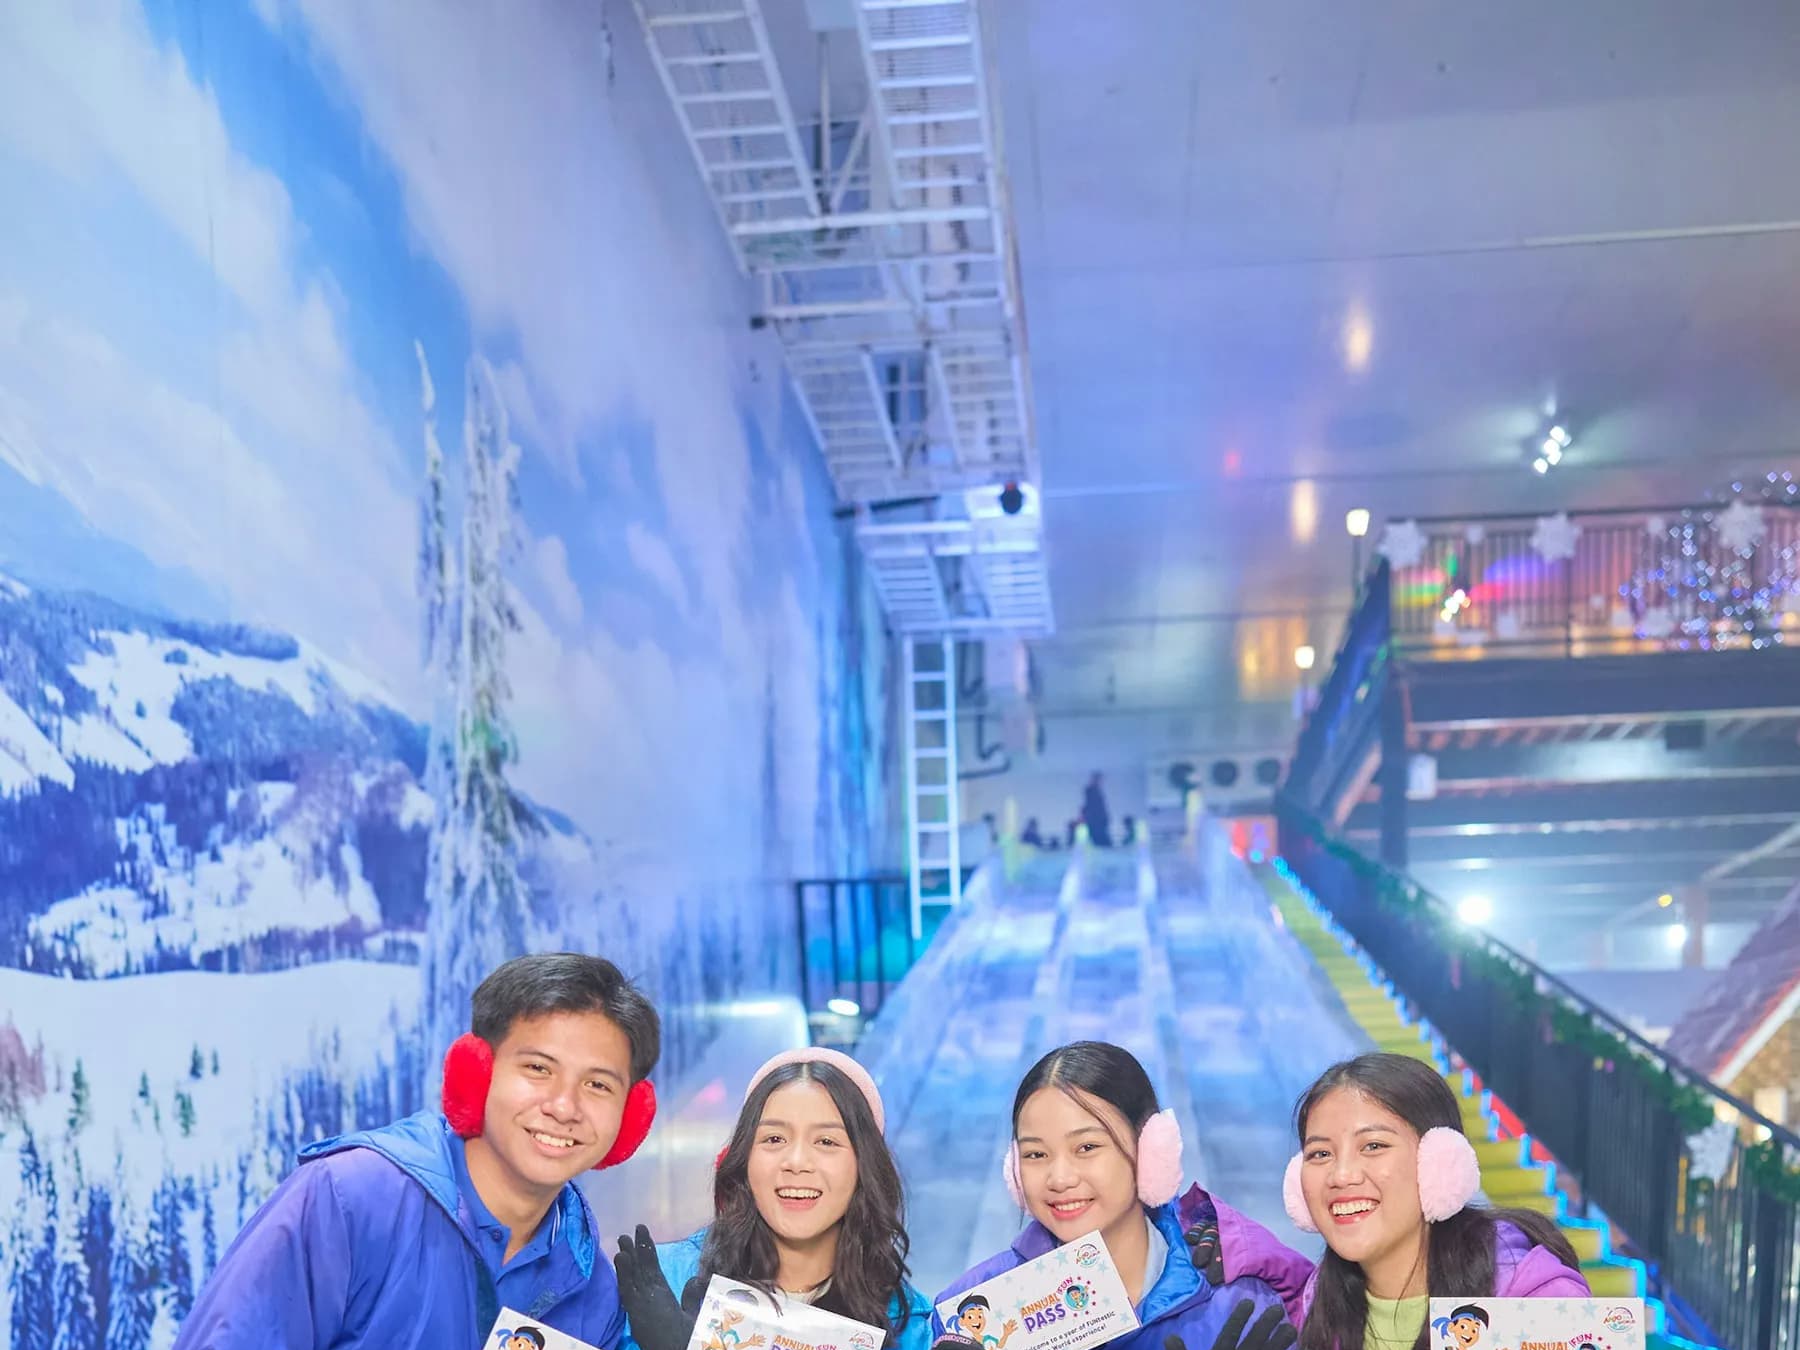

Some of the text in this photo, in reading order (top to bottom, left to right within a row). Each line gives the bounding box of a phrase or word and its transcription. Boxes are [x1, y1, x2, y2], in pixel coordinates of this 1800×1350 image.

[1057, 1276, 1073, 1294] FUN
[1020, 1293, 1060, 1317] ANNUAL
[1024, 1303, 1066, 1332] PASS
[1050, 1336, 1058, 1344] to
[1064, 1328, 1077, 1337] year
[1086, 1311, 1115, 1327] FUNtastic
[1052, 1340, 1071, 1350] World
[1570, 1333, 1592, 1346] FUN
